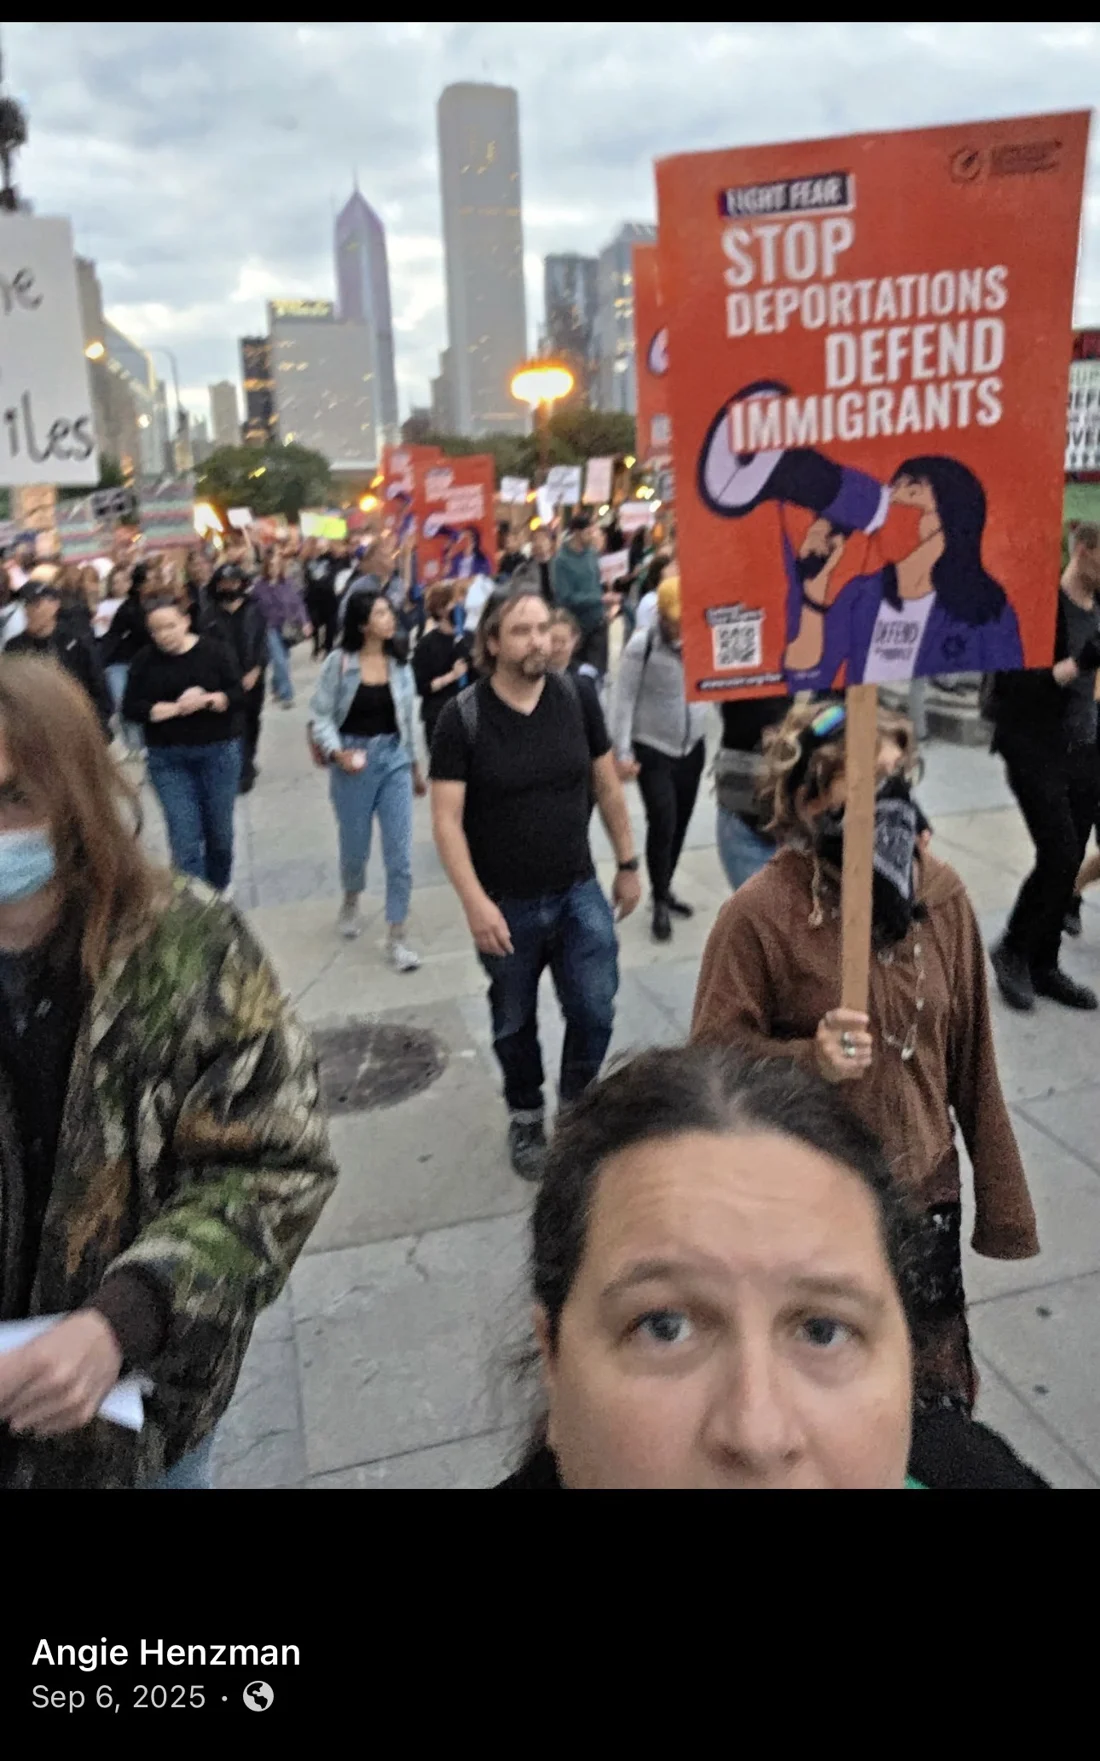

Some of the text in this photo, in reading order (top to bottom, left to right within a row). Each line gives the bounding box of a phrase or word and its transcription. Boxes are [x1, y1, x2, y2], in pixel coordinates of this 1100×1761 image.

[721, 217, 855, 287] STOP
[726, 265, 1008, 338] DEPORTATIONS
[825, 317, 1005, 389] DEFEND
[730, 377, 1003, 454] IMMIGRANTS
